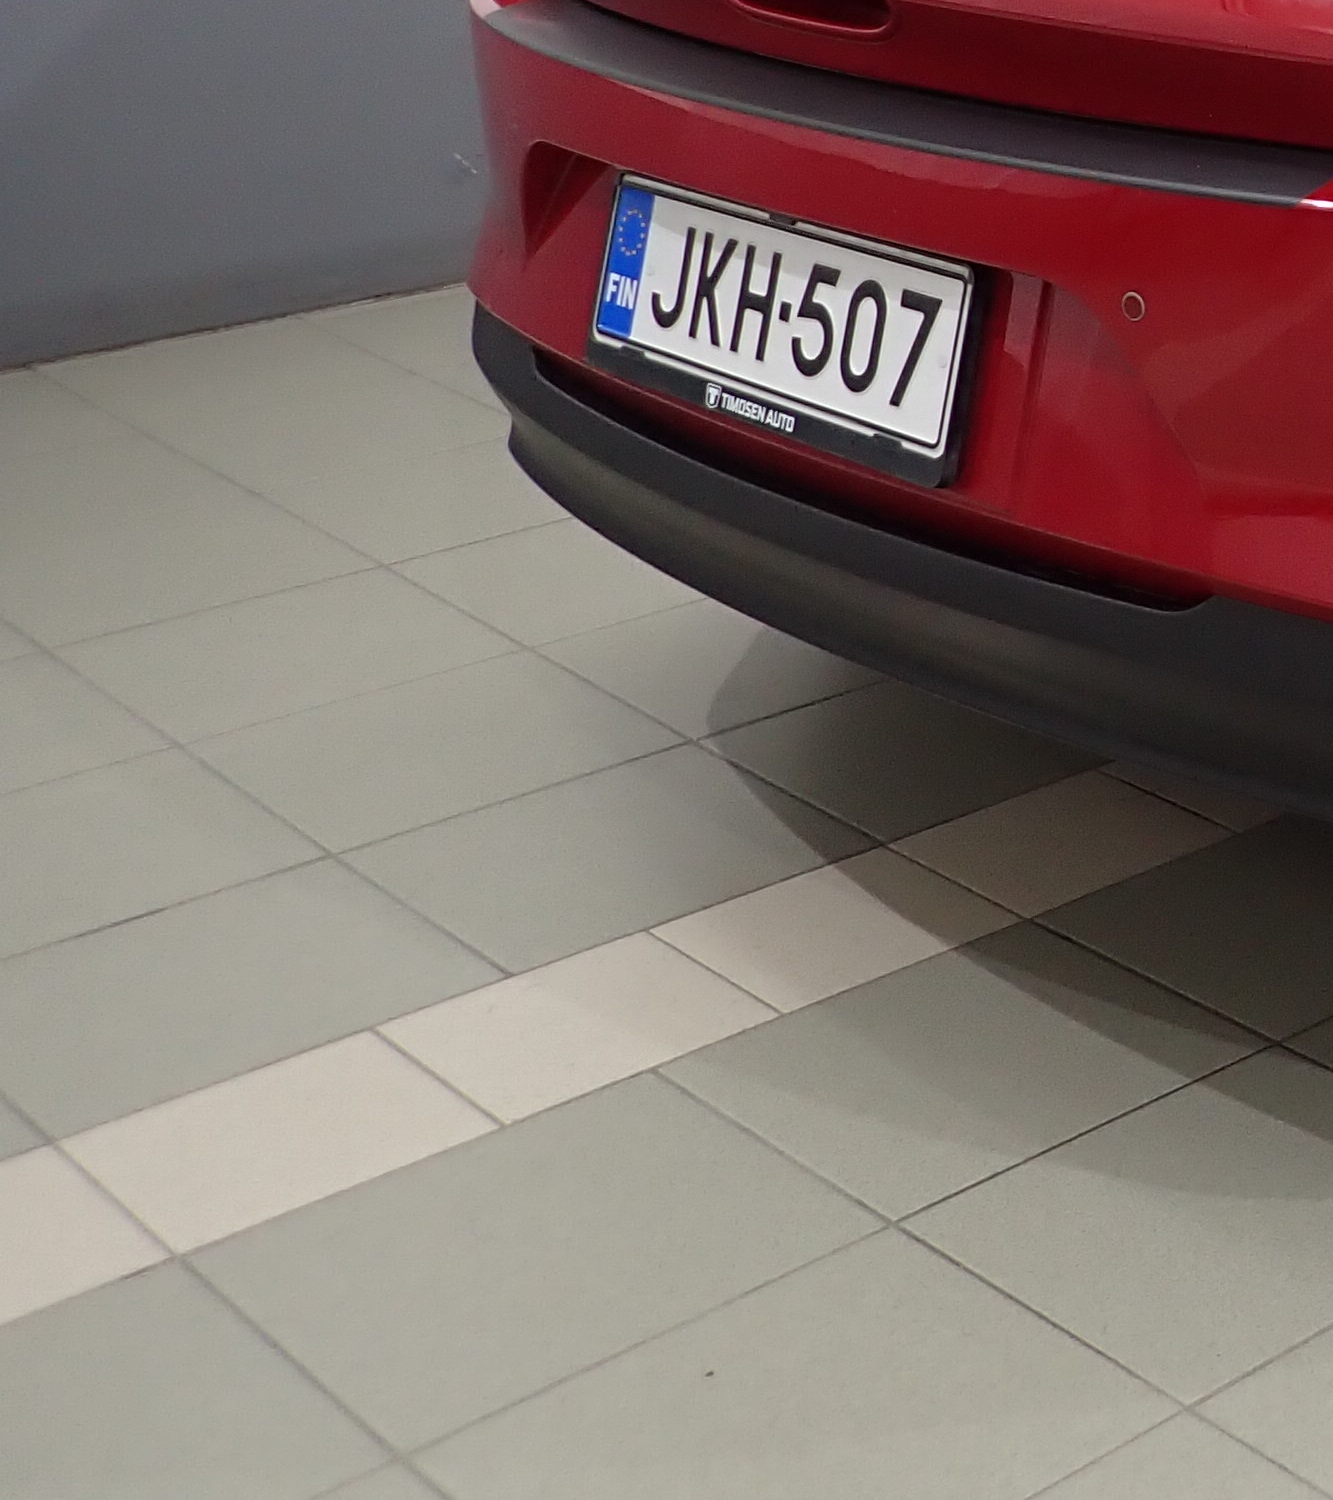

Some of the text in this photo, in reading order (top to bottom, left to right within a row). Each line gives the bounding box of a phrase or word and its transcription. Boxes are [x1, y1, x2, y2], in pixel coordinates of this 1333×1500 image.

[607, 272, 637, 311] FIN
[651, 226, 943, 408] JKH-507
[720, 392, 767, 424] TIMOSEN
[764, 409, 796, 434] AUTO
